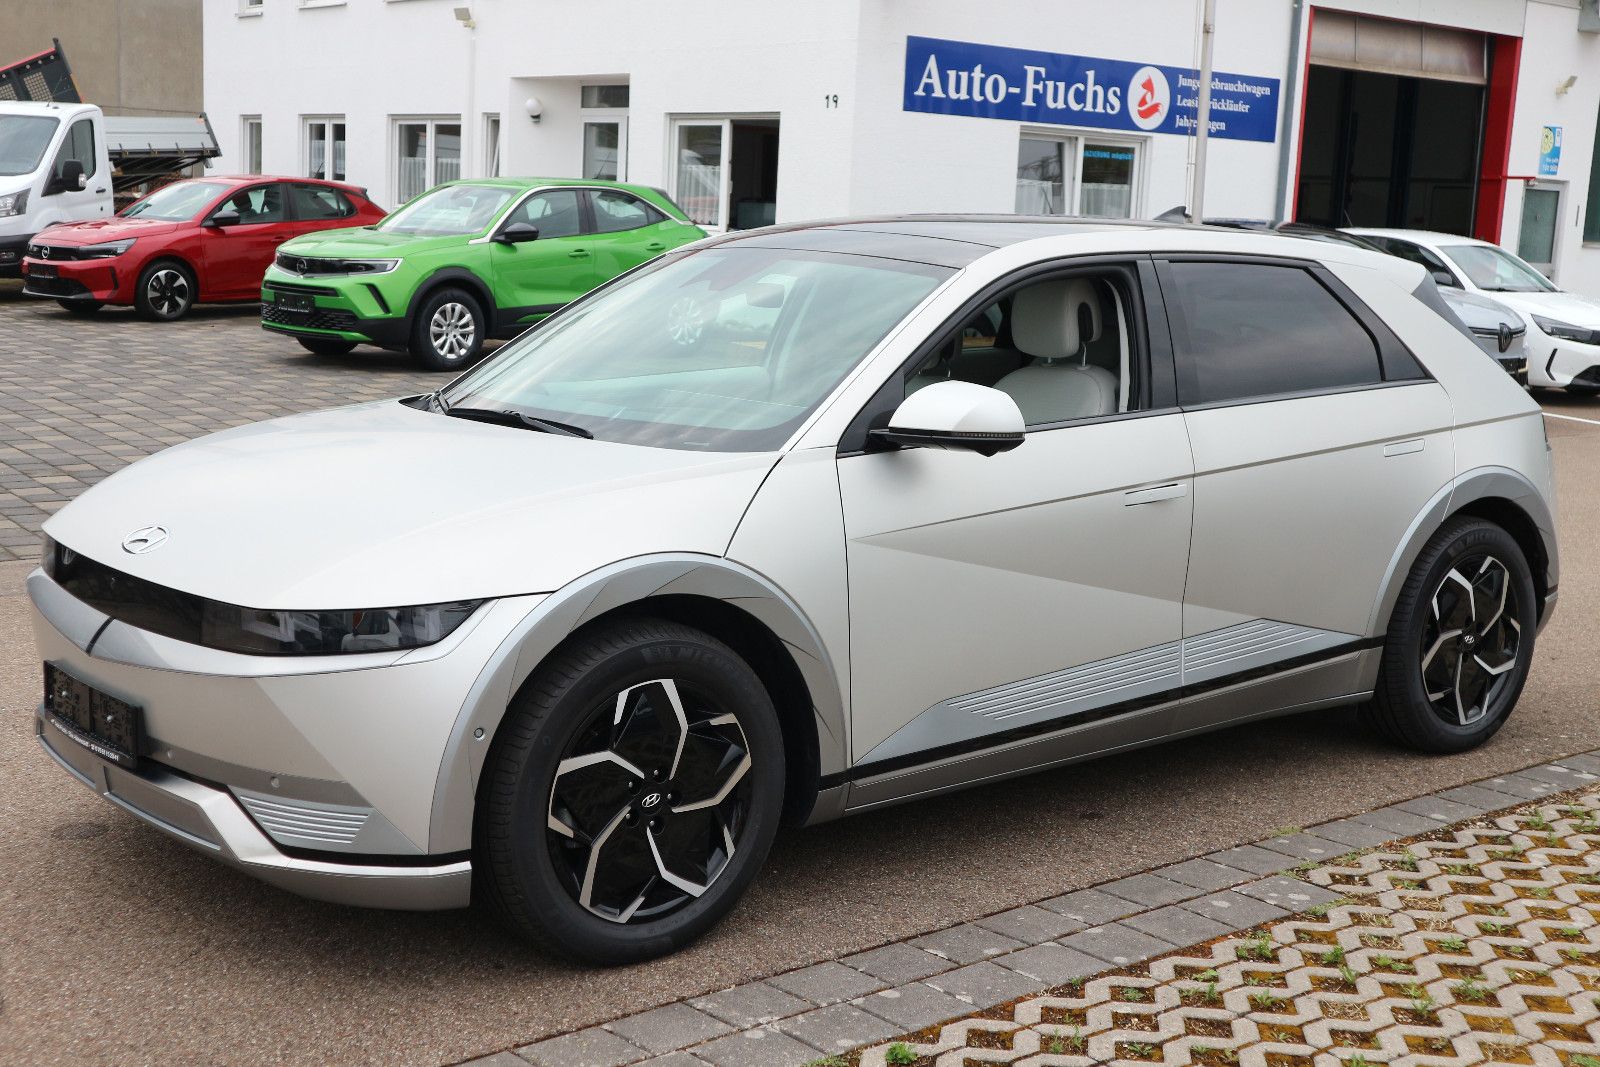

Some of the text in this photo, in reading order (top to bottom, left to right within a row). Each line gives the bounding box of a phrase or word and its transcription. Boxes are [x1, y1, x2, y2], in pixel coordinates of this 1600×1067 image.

[914, 54, 1121, 115] Auto-Fuchs
[1207, 78, 1271, 97] ebrauchtwagen
[825, 94, 839, 109] 19
[1176, 94, 1250, 113] Leasirückläufer
[1175, 114, 1226, 132] Jahreagen
